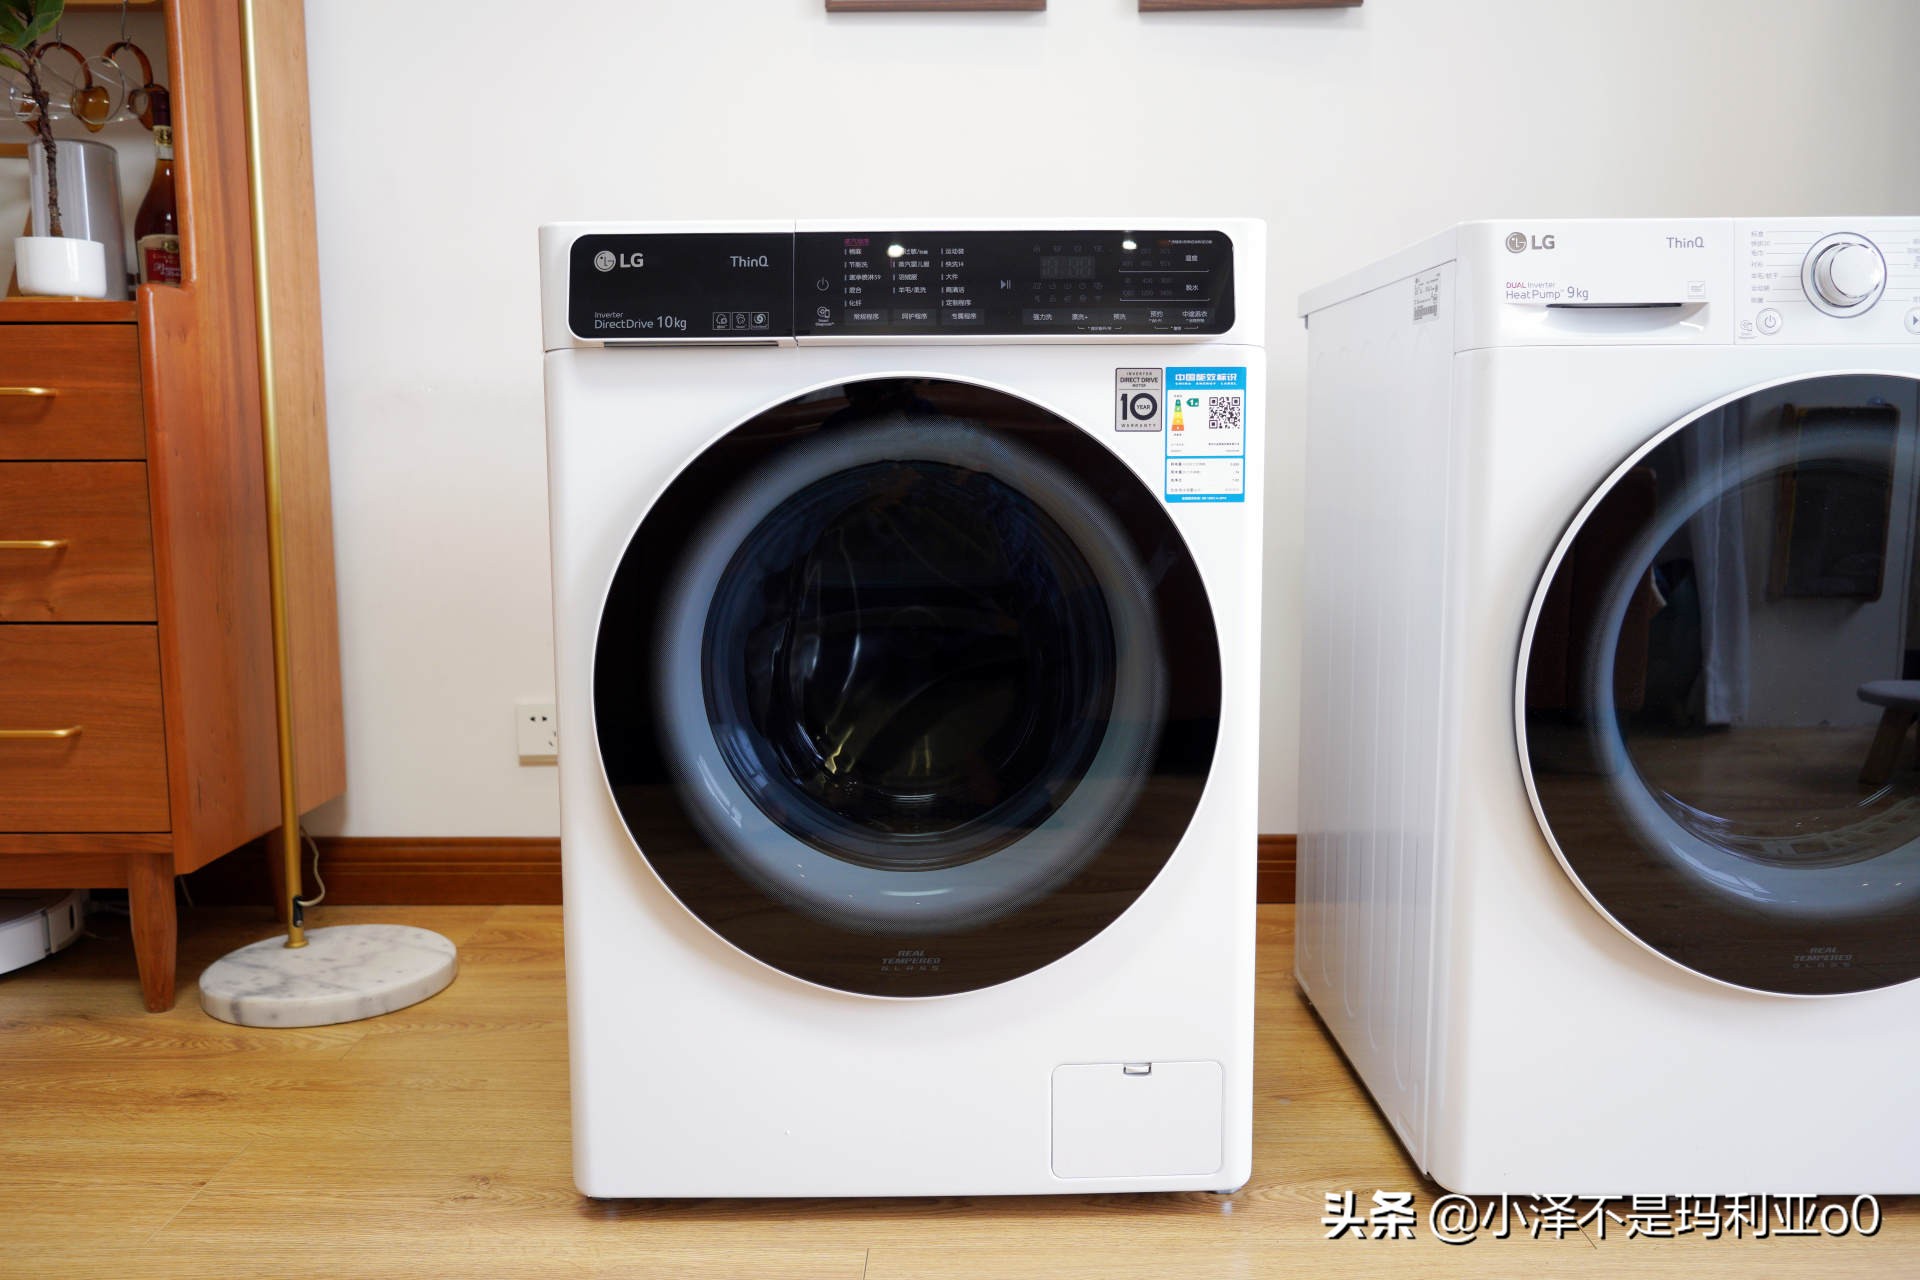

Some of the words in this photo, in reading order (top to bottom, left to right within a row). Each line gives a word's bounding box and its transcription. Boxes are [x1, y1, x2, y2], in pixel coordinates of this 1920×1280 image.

[1531, 234, 1556, 250] LG
[1666, 236, 1705, 248] ThinQ
[619, 253, 644, 268] LG
[730, 255, 769, 268] ThinQ
[1506, 281, 1527, 289] DUAL
[594, 319, 654, 329] DirectDrive
[1119, 376, 1140, 384] DIRECT
[1175, 373, 1238, 382] 中国能效标识
